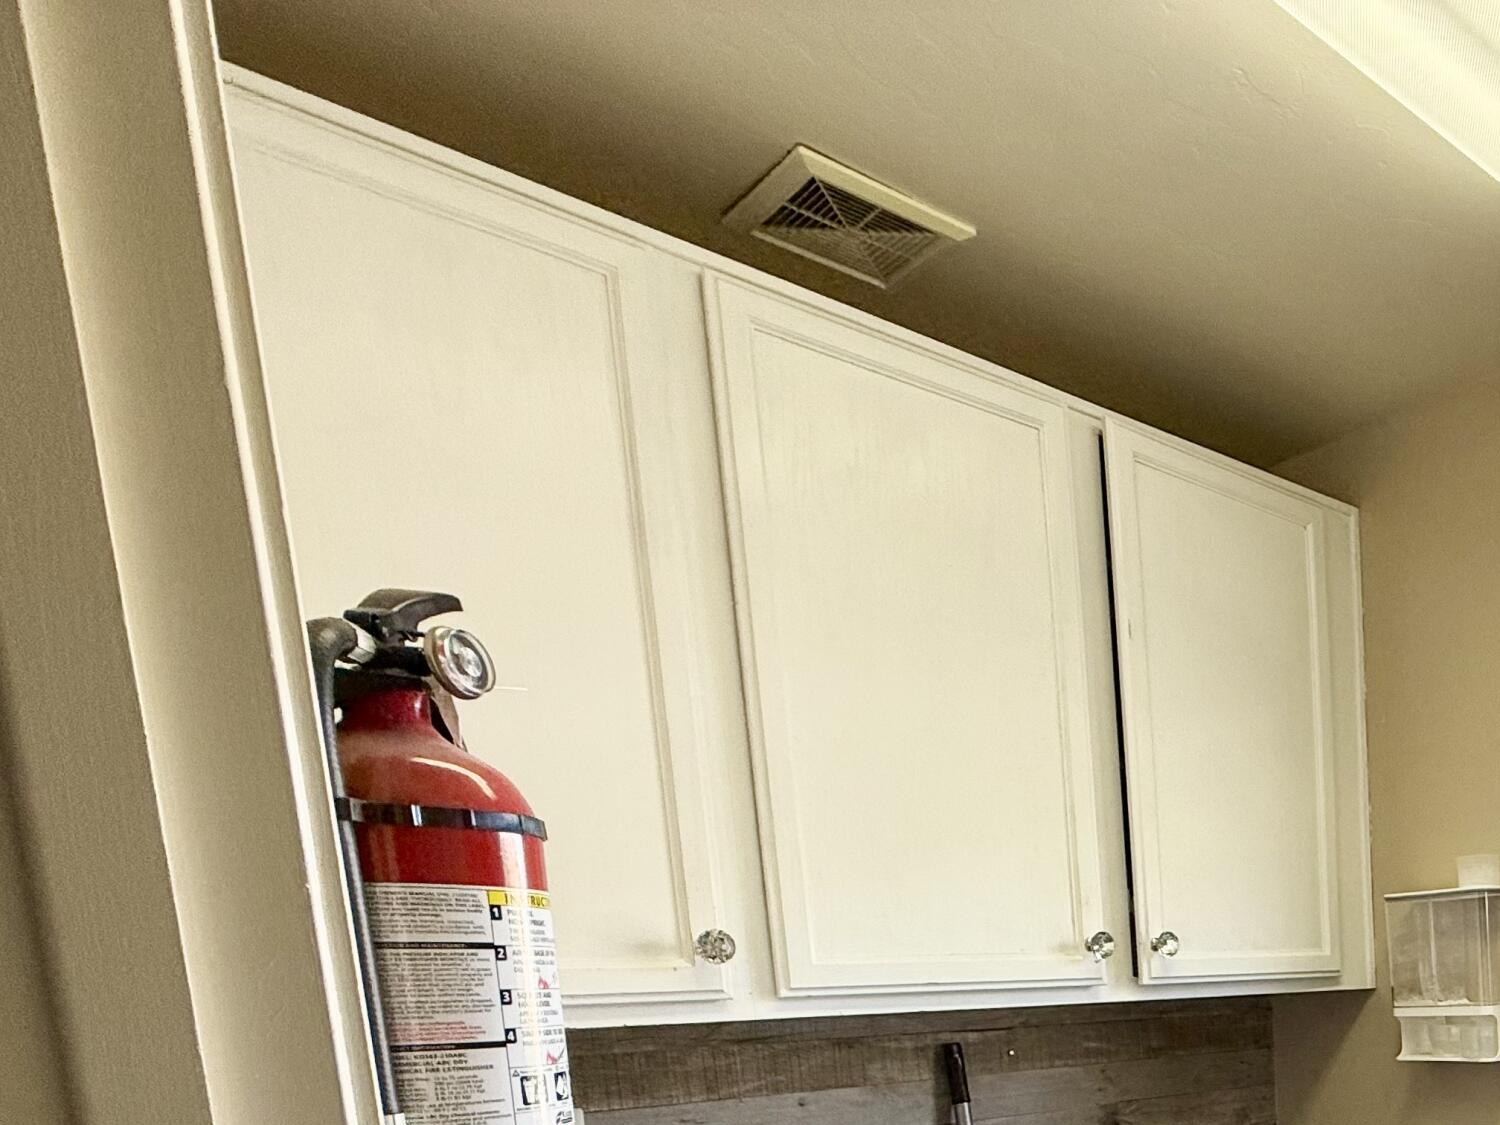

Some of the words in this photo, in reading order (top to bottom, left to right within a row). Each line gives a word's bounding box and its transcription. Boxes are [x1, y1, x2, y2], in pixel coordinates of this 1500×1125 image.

[491, 906, 500, 918] 1
[496, 947, 506, 959] 2
[502, 991, 511, 1002] 3
[507, 1030, 516, 1041] 4
